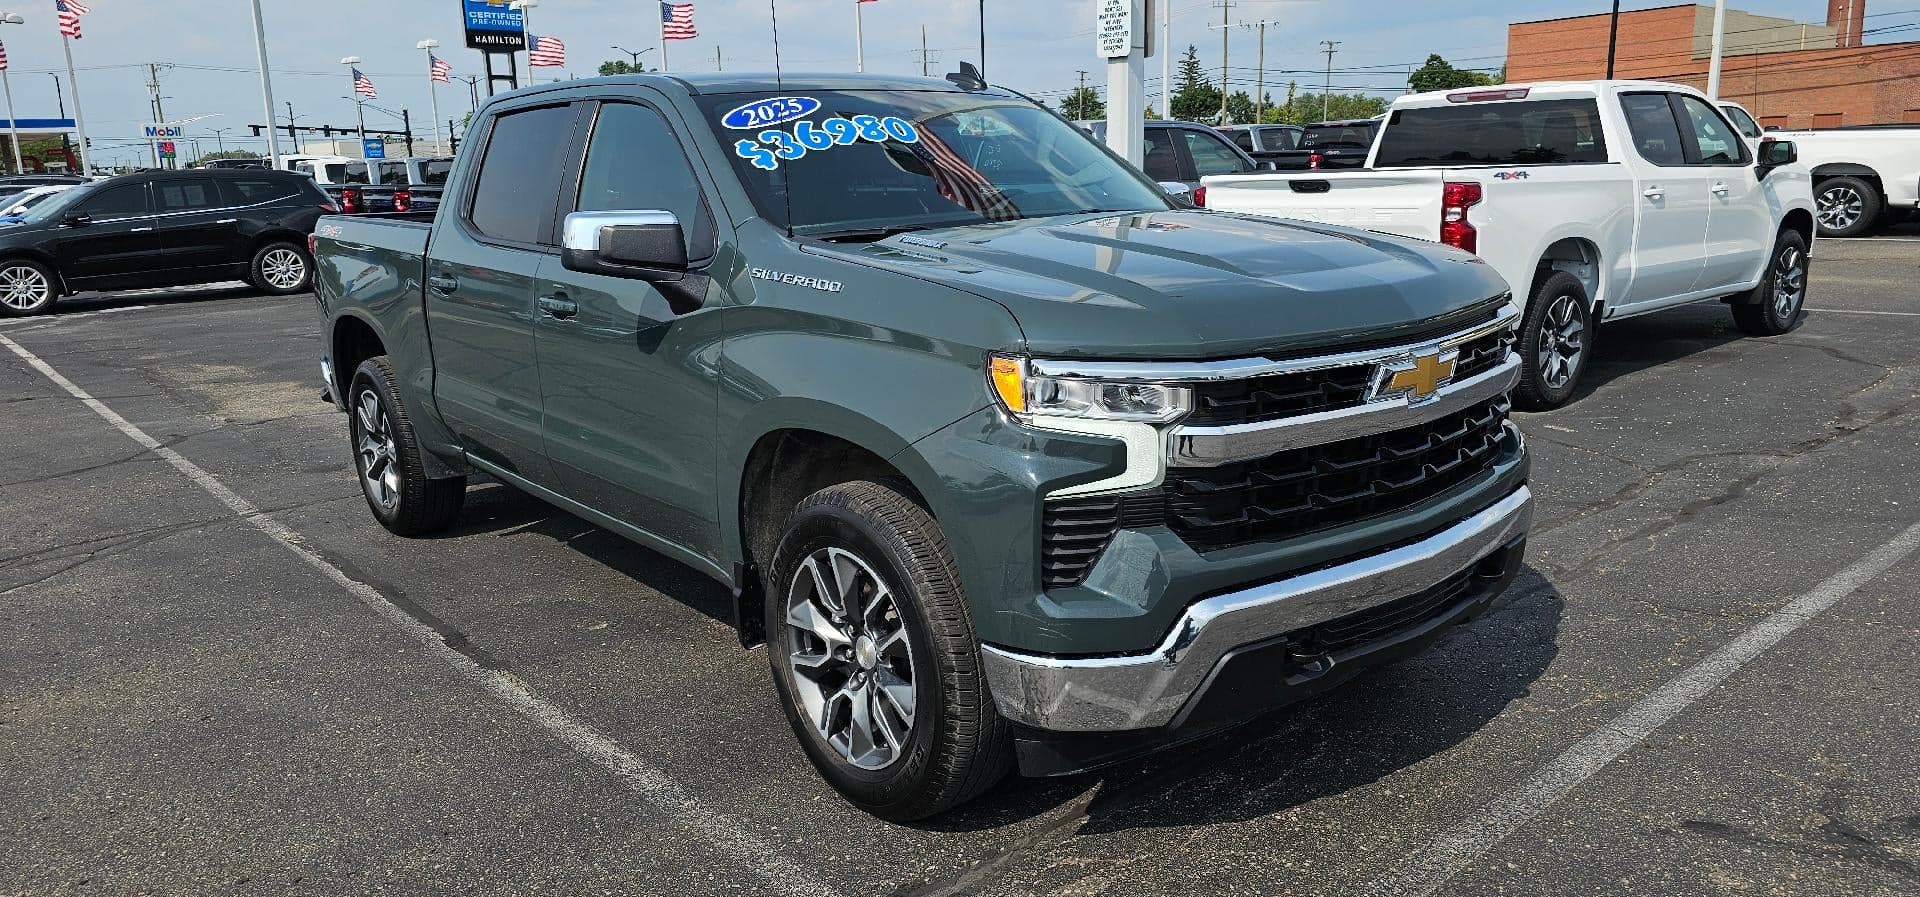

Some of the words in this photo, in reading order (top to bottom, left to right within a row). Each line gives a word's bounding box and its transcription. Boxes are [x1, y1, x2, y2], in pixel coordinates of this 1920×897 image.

[469, 11, 523, 21] CERTIFIED
[472, 18, 521, 27] PRE-OWNED
[475, 35, 522, 45] HAMILTON
[741, 98, 803, 126] 2025
[145, 126, 182, 137] Mobil
[734, 114, 920, 171] $36980
[751, 267, 842, 293] SILVERADO
